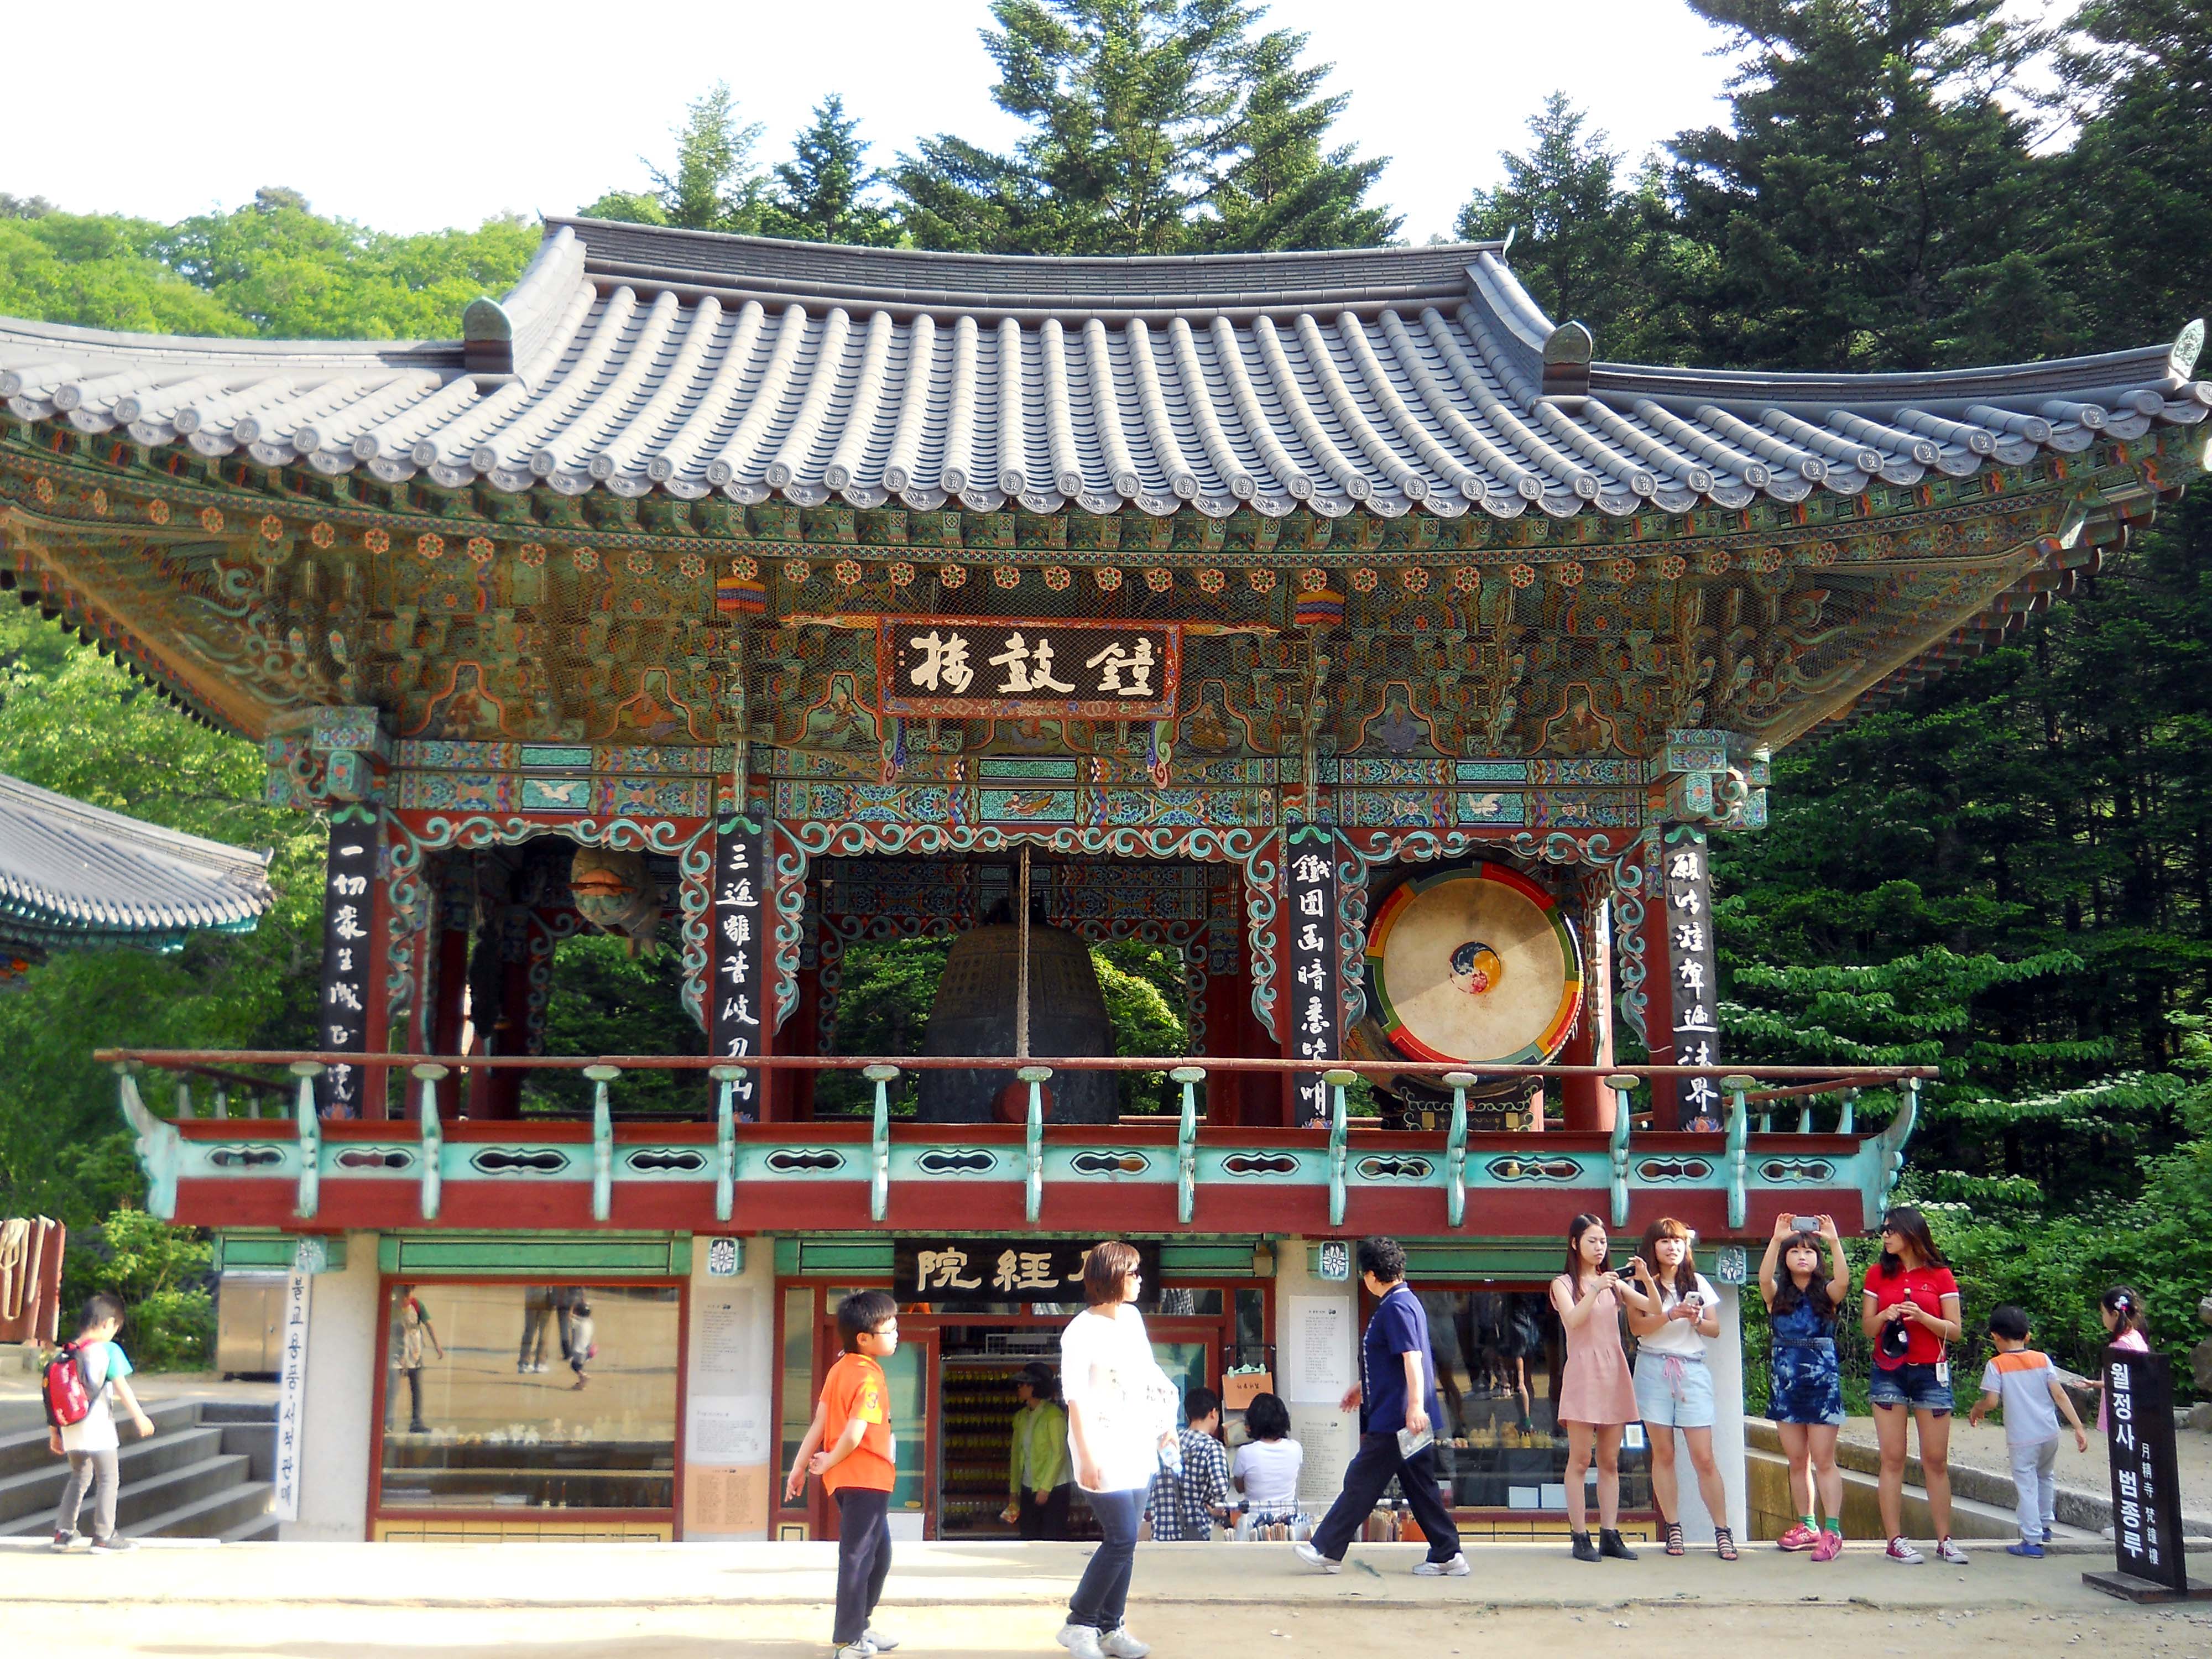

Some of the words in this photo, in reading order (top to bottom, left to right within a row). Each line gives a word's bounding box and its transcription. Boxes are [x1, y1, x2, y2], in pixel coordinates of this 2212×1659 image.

[2110, 1363, 2135, 1452] 월정사
[2119, 1469, 2143, 1559] 범종루
[2141, 1442, 2154, 1499] 月精寺
